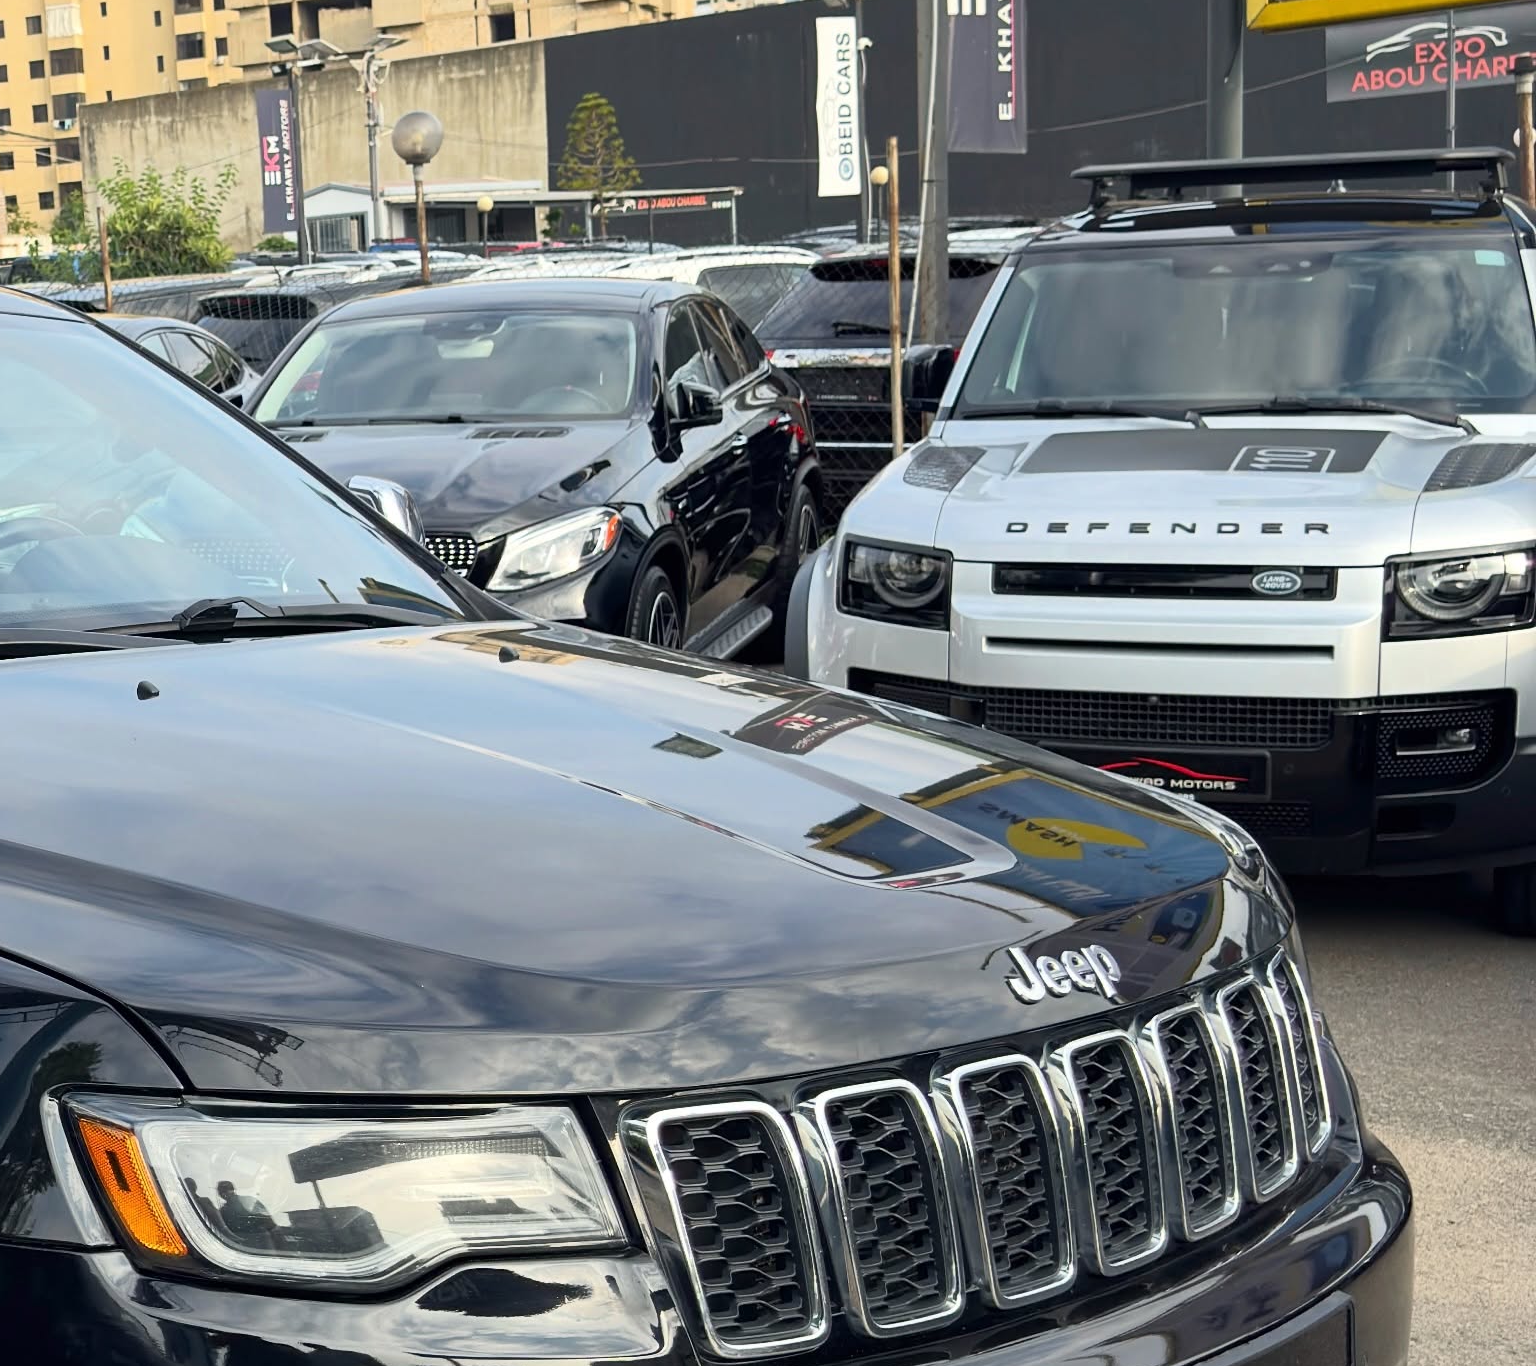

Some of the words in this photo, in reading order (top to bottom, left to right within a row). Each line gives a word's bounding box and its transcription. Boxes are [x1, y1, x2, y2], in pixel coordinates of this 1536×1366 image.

[836, 33, 852, 95] CARS
[1351, 65, 1425, 93] ABOU
[262, 136, 281, 185] EKM
[1005, 522, 1329, 535] DEFENDER
[1170, 779, 1236, 791] MOTORS
[1005, 944, 1122, 1004] Jeep
